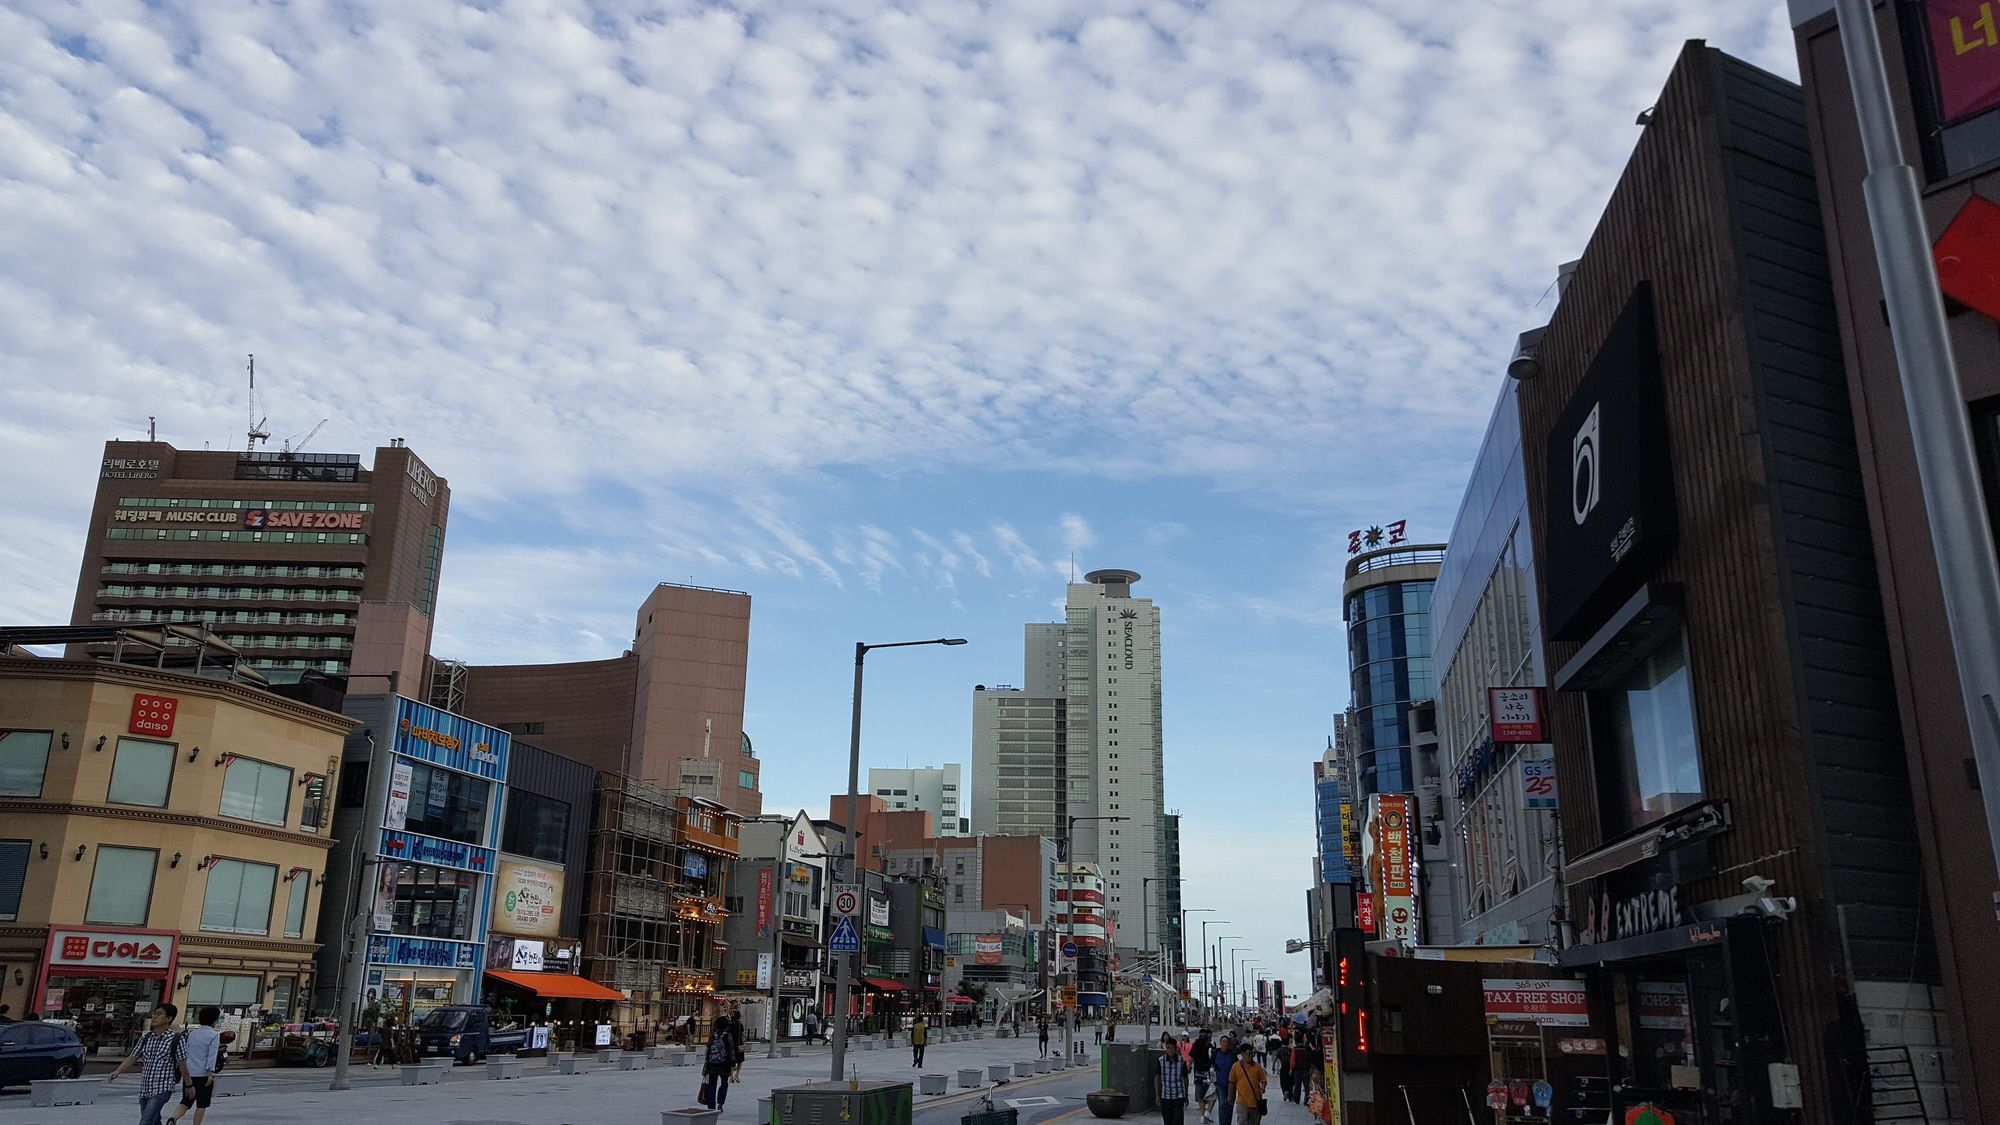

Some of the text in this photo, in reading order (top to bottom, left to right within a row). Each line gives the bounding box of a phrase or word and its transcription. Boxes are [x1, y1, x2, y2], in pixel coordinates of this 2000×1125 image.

[103, 458, 160, 470] 리베로호텔
[101, 471, 157, 479] HOTEL LIBERO
[406, 455, 437, 497] LIBERO
[165, 511, 205, 522] MUSIC
[206, 512, 238, 523] CLUB
[267, 512, 314, 528] SAVE
[314, 512, 363, 529] ZONE
[1124, 620, 1134, 670] SEACLOUD
[1501, 713, 1530, 721] 이야기
[136, 720, 168, 732] daiso
[1525, 766, 1542, 776] GS
[1526, 776, 1555, 795] 25
[1387, 830, 1406, 881] 백철판
[840, 897, 851, 909] 30
[1615, 884, 1682, 940] EXTREME
[92, 941, 162, 960] 다이소
[1515, 981, 1551, 990] 365 DAY
[1485, 991, 1585, 1004] TAX FREE SHOP
